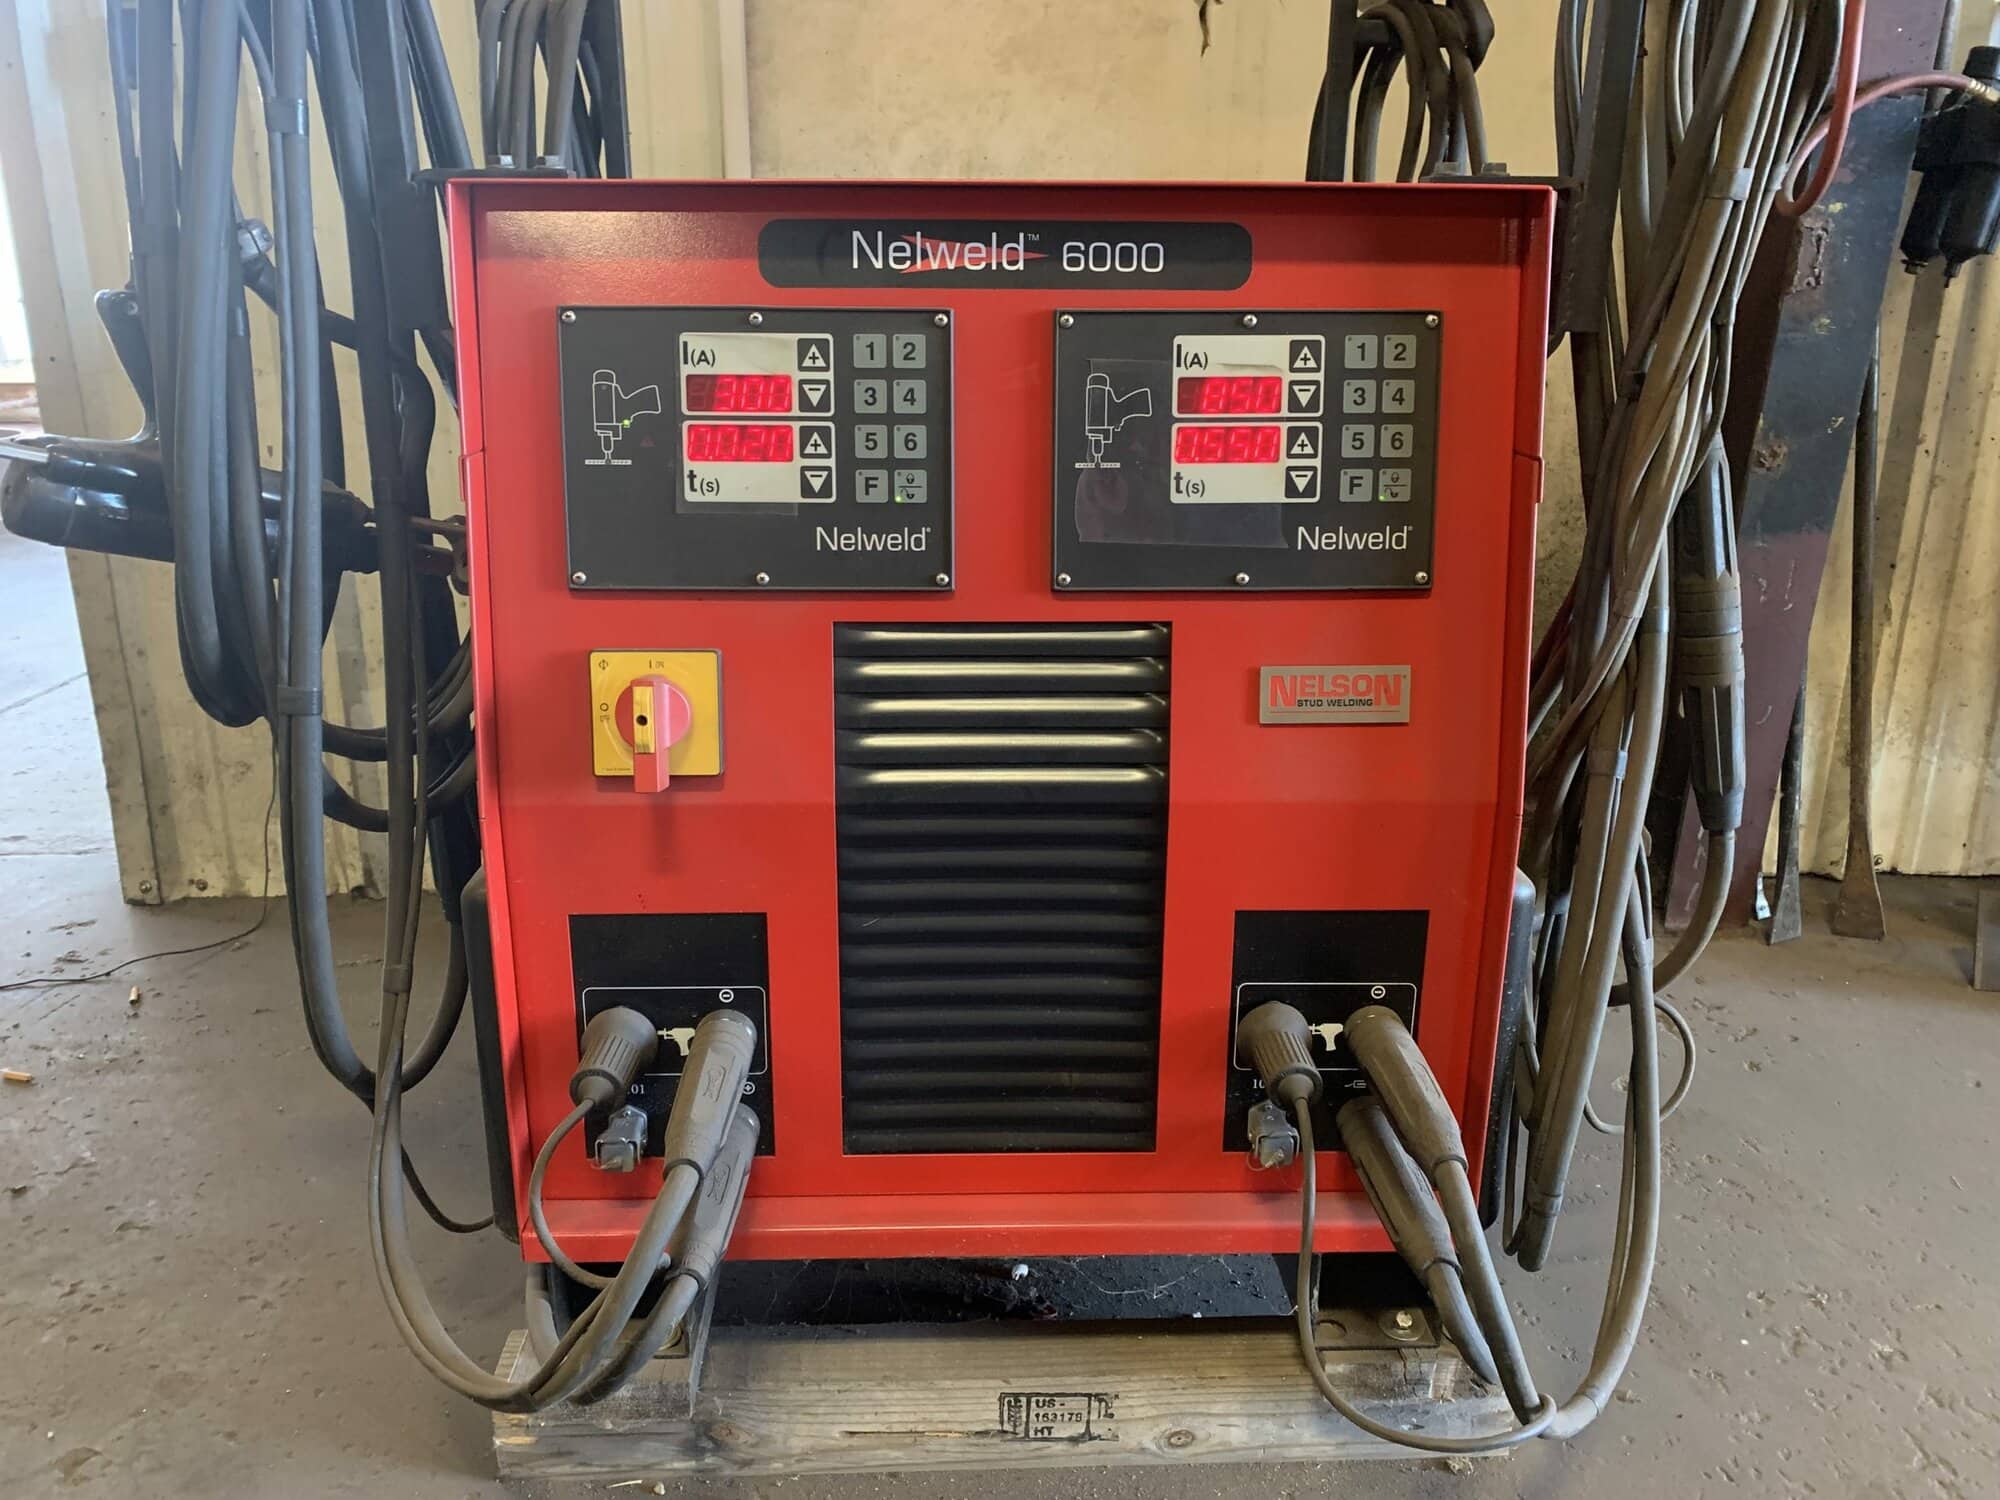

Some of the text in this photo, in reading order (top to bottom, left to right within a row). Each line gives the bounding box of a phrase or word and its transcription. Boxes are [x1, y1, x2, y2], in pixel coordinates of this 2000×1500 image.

[1062, 241, 1164, 272] 6000
[865, 341, 875, 360] 1
[902, 342, 917, 360] 2
[1356, 342, 1366, 361] 1
[1393, 342, 1407, 361] 2
[863, 387, 877, 406] 3
[903, 387, 917, 406] 4
[1353, 387, 1366, 406] 3
[1391, 387, 1405, 406] 4
[864, 432, 878, 451] 5
[904, 432, 918, 451] 6
[1351, 432, 1365, 450] 5
[1390, 431, 1404, 450] 6
[864, 476, 879, 495] F
[1348, 476, 1364, 495] F
[1297, 698, 1373, 707] STUD WELDING
[1034, 1426, 1054, 1436] HT
